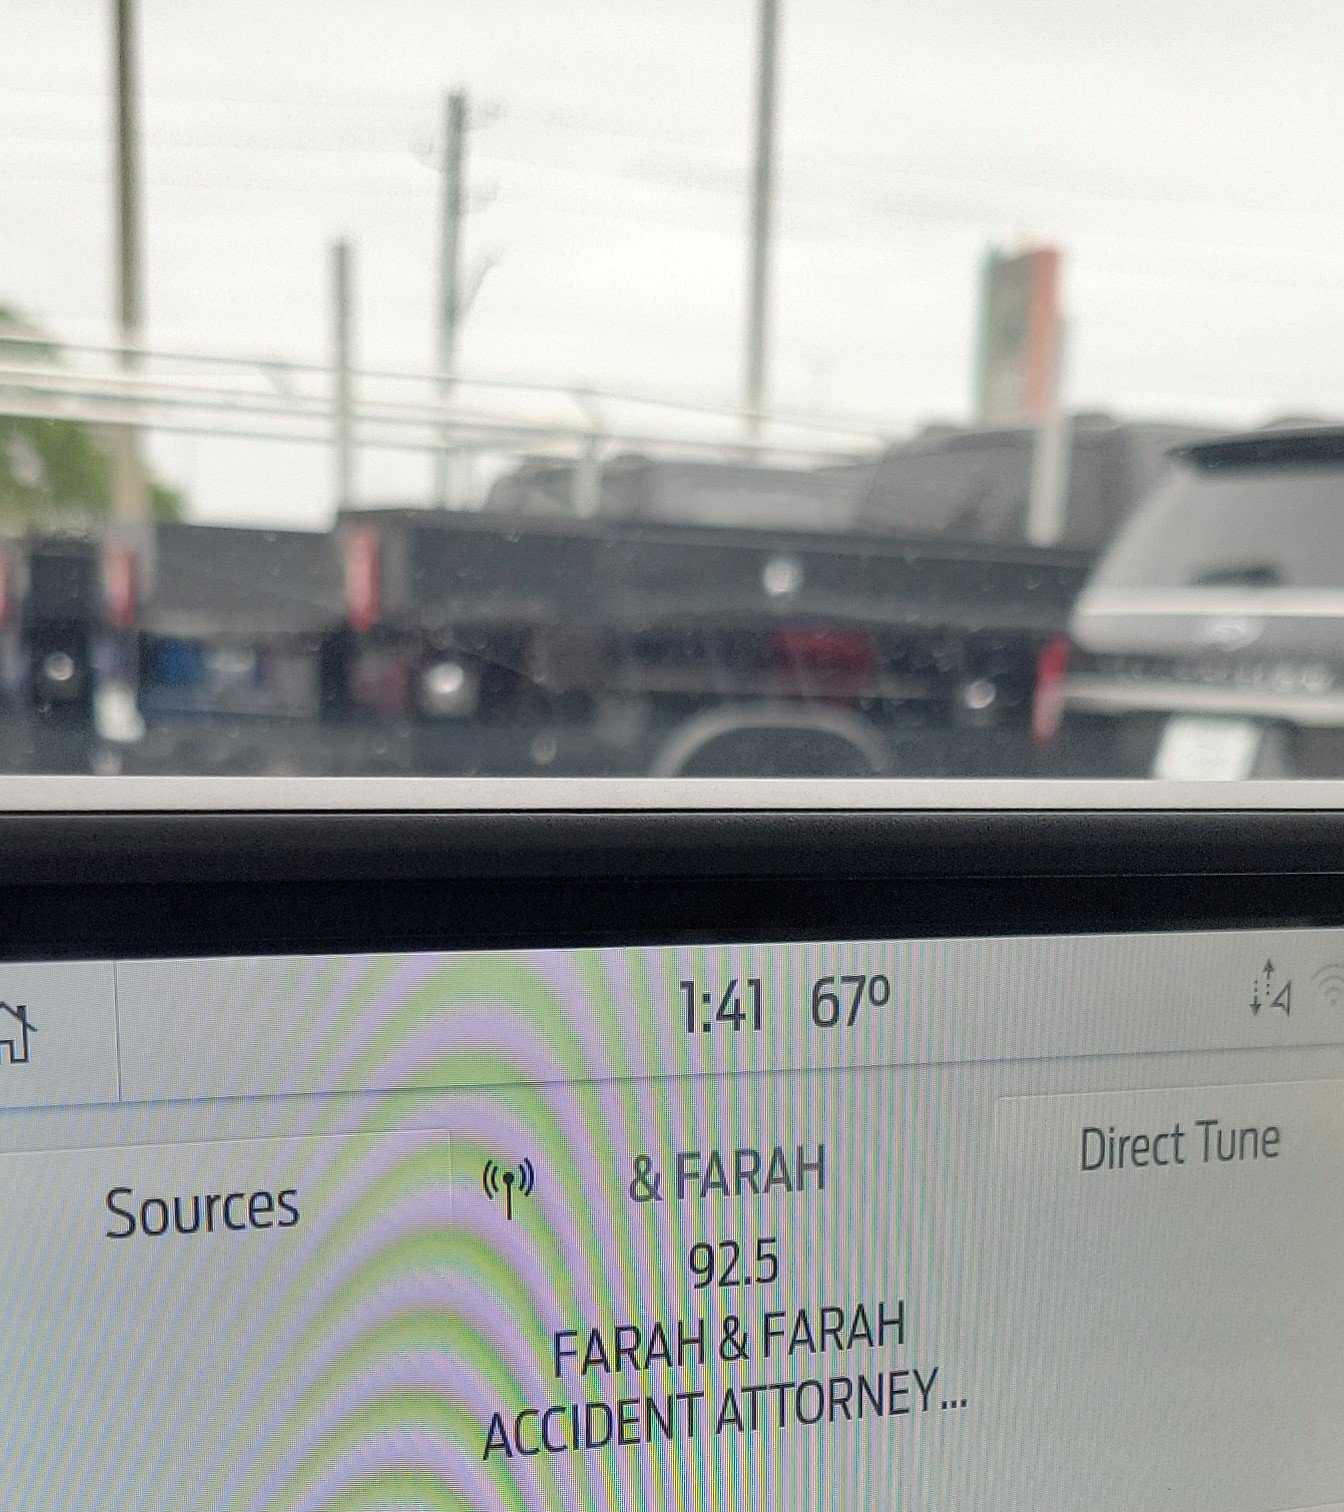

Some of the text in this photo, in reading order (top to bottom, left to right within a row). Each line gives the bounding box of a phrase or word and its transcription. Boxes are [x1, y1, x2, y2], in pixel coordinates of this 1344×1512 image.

[679, 977, 763, 1035] 1:41
[628, 1144, 826, 1203] & FARAH
[1080, 1119, 1281, 1172] Direct Tune
[105, 1186, 301, 1240] Sources
[688, 1237, 780, 1290] 92.5
[553, 1300, 906, 1379] FARAH & FARAH
[482, 1392, 705, 1461] ACCIDENT
